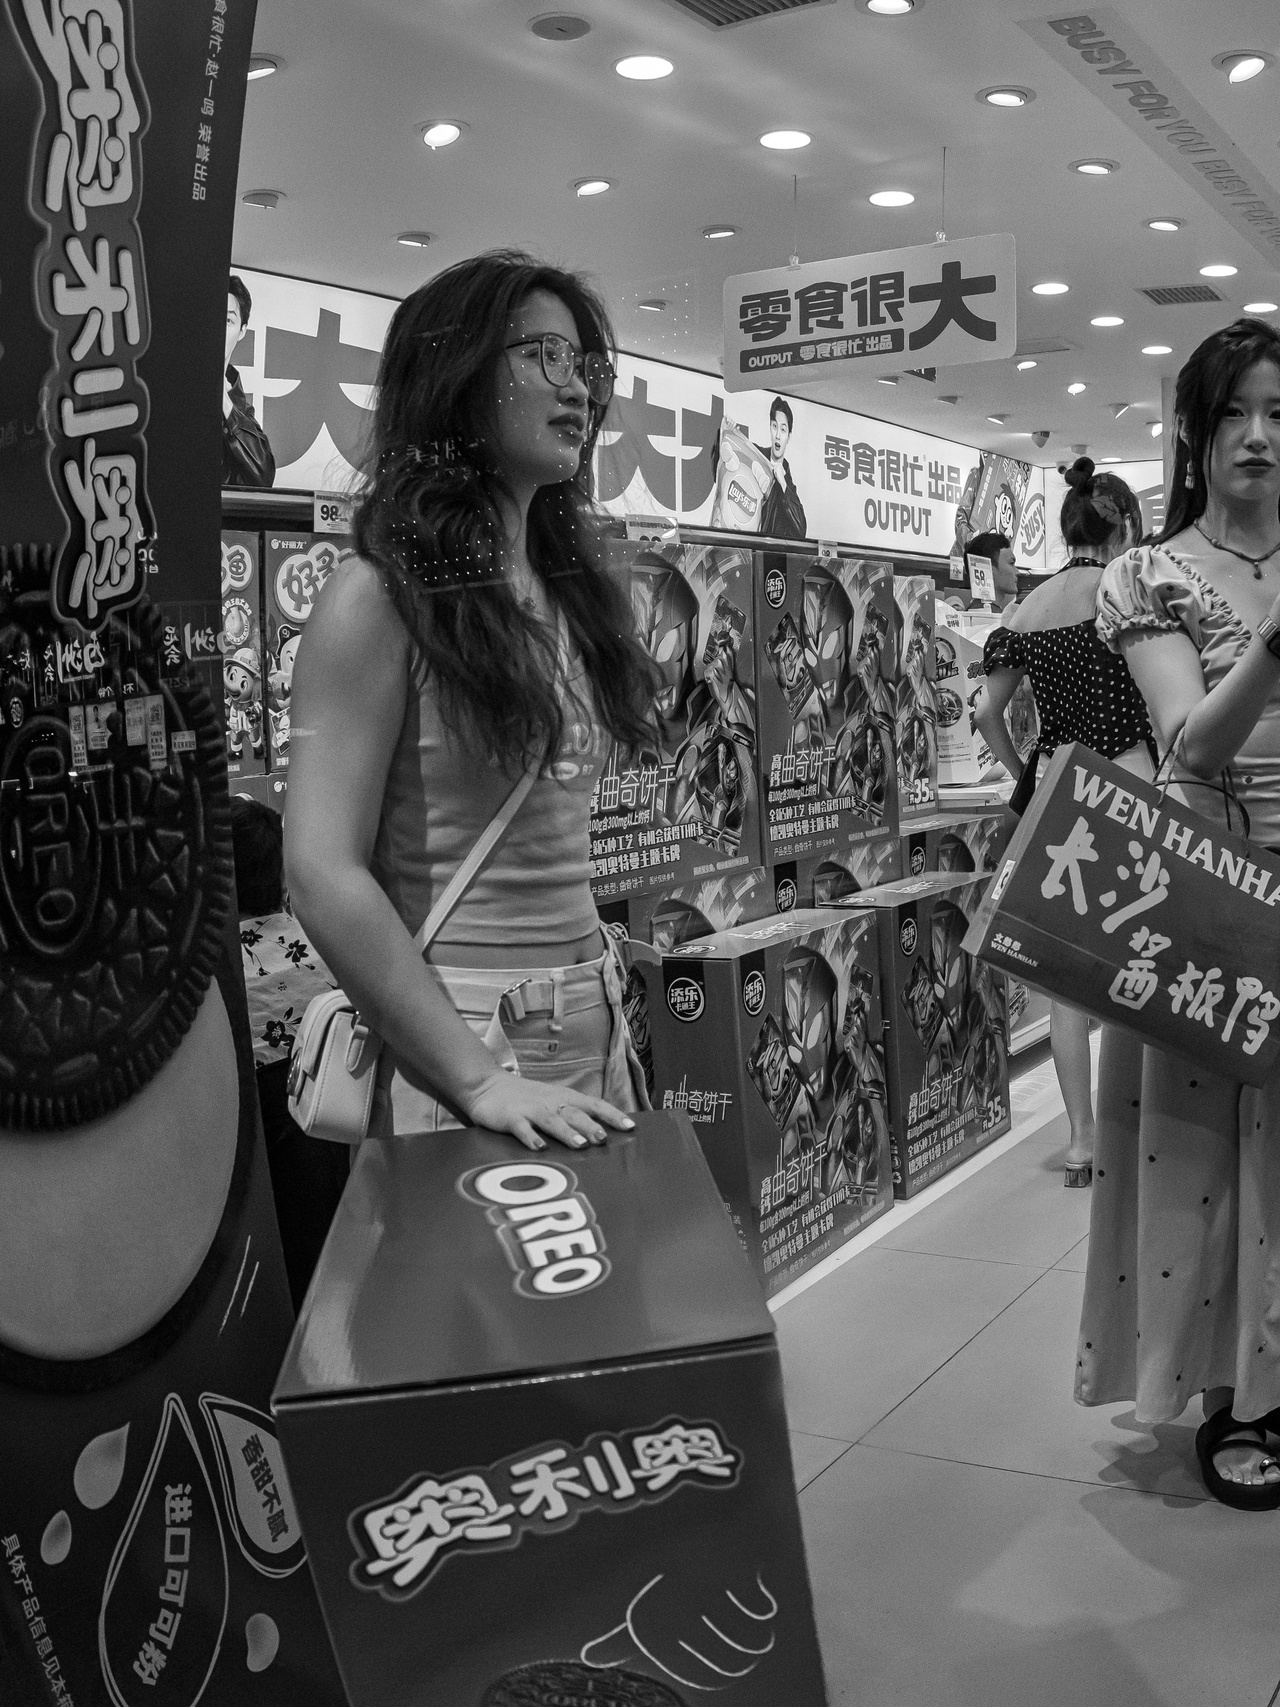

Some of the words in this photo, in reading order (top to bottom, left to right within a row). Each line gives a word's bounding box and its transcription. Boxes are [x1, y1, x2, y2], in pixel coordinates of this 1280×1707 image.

[1047, 15, 1142, 76] BUSY
[1112, 80, 1181, 121] FOR
[1155, 119, 1217, 155] YOU
[1191, 159, 1258, 197] BUSY
[191, 122, 213, 201] 荣誉出品
[739, 261, 997, 352] 零食很大
[748, 350, 794, 368] OUTPUT
[799, 335, 863, 361] 零食很忙
[865, 334, 893, 352] 出品
[824, 435, 924, 497] 零食很忙
[927, 459, 963, 504] 出品
[320, 504, 339, 522] 98
[864, 497, 932, 537] OUTPUT
[1022, 501, 1044, 547] BUSY
[601, 742, 676, 822] 曲奇饼干
[769, 754, 783, 787] 高钙
[782, 725, 836, 794] 曲奇饼干
[1072, 764, 1163, 839] WEN
[25, 746, 77, 928] OREO
[1040, 816, 1171, 935] 长沙
[671, 986, 699, 1004] 添乐
[745, 977, 762, 1001] 添乐
[675, 1074, 733, 1123] 曲奇饼干
[918, 1061, 963, 1118] 曲奇饼干
[760, 1176, 773, 1217] 高钙
[772, 1138, 828, 1206] 曲奇饼干
[474, 1164, 603, 1295] OREO
[239, 1433, 292, 1543] 香甜不腻
[362, 1424, 735, 1588] 奥利奥
[131, 1483, 193, 1686] 进口可可粉
